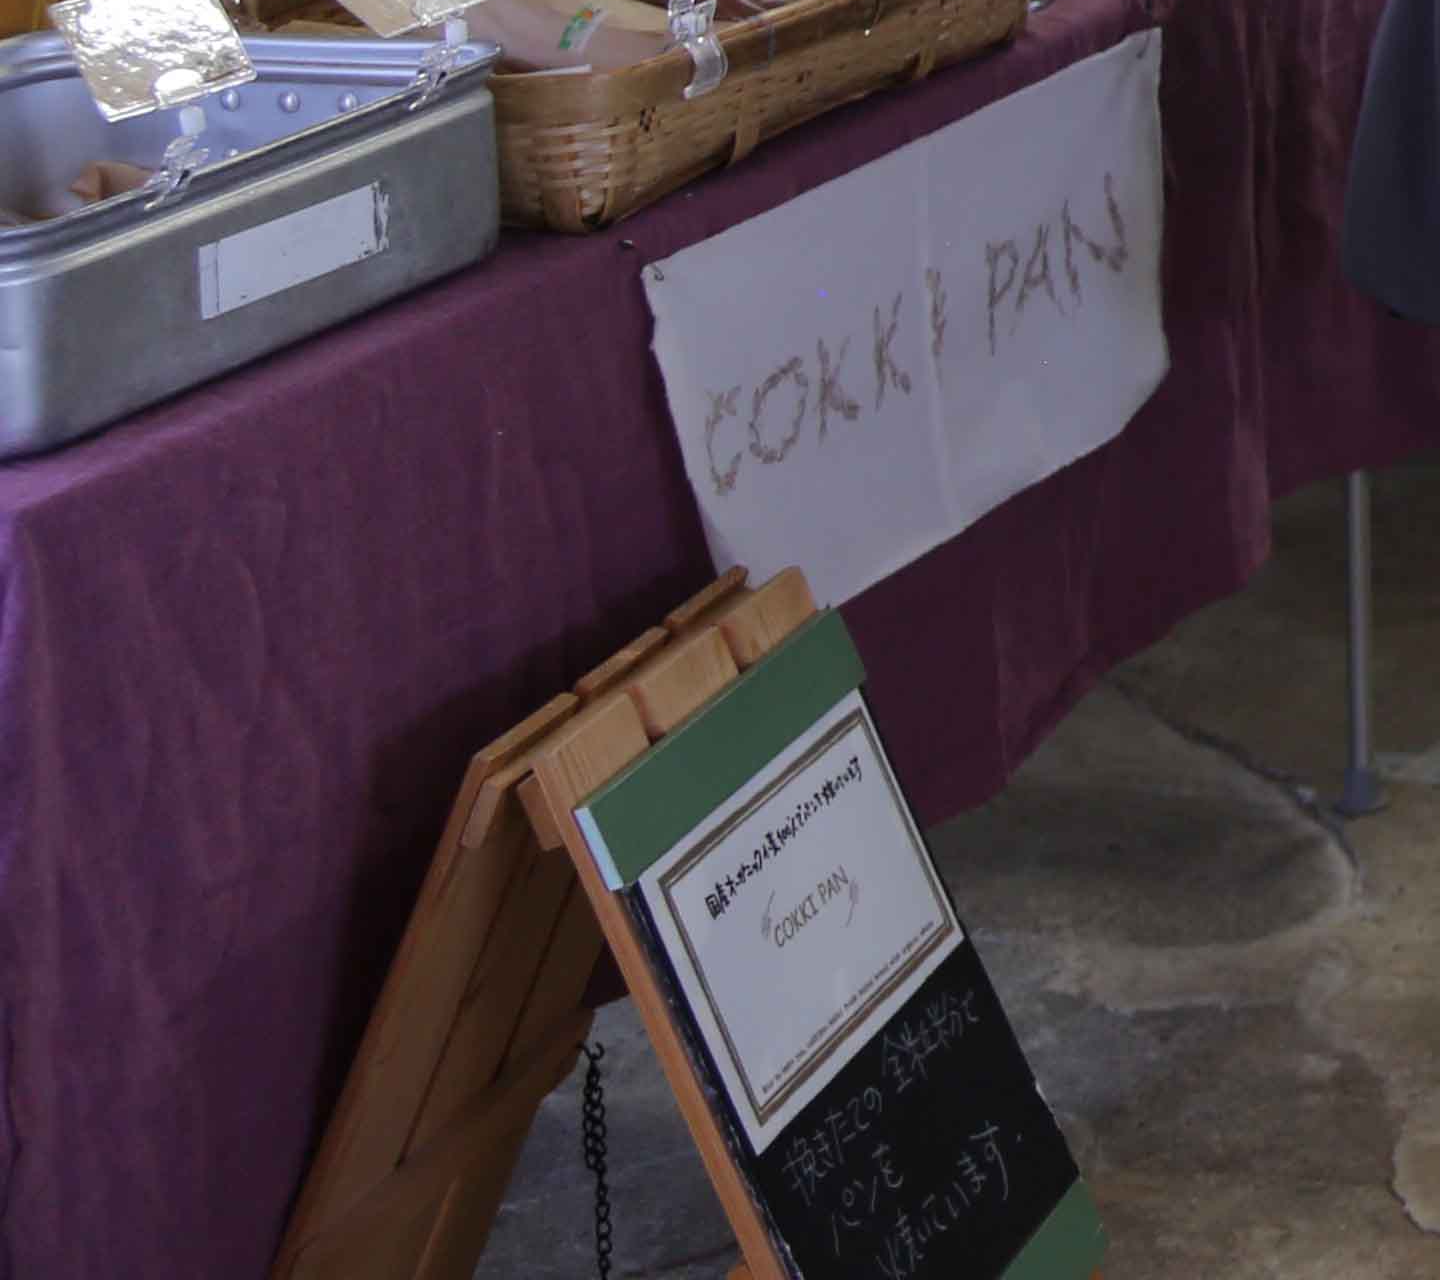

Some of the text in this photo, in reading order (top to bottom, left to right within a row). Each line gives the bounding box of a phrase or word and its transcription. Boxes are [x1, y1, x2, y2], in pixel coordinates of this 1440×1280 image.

[705, 171, 1130, 497] COKKI PAN
[774, 864, 849, 948] COKKI PAN
[831, 1142, 904, 1257] パンを
